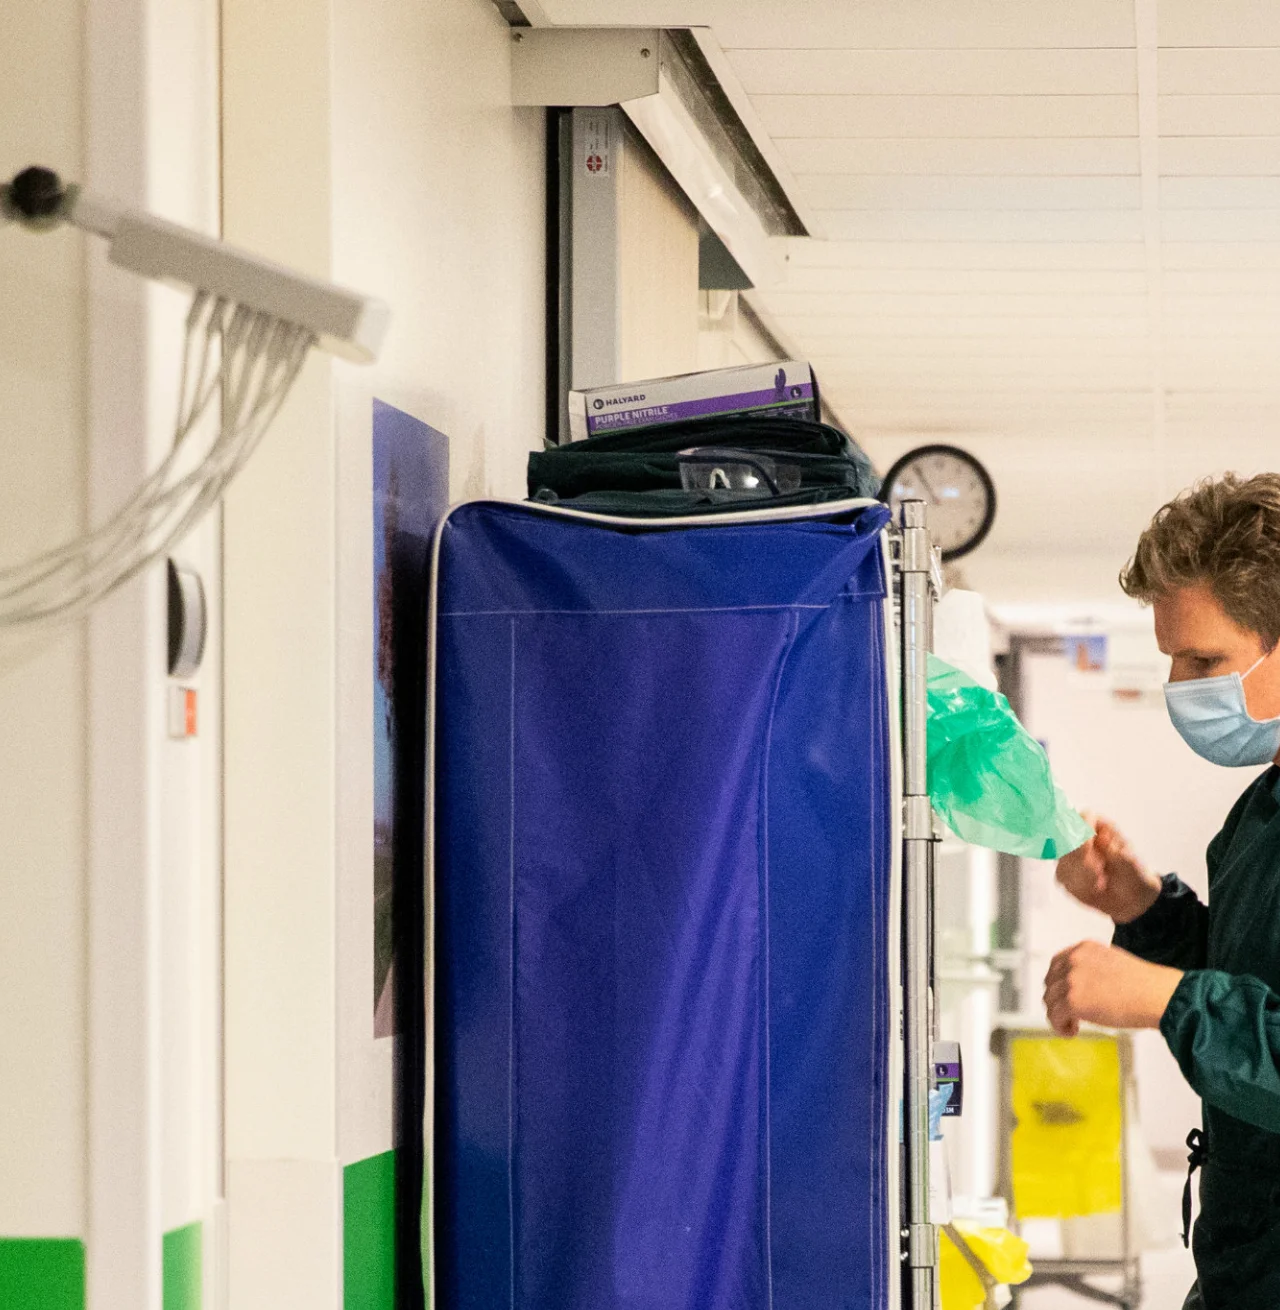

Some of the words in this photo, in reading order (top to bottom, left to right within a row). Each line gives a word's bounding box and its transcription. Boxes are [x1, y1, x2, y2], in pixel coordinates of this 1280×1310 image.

[605, 394, 646, 406] HALYARD
[594, 412, 631, 425] PURPLE
[631, 406, 669, 421] NITRILE
